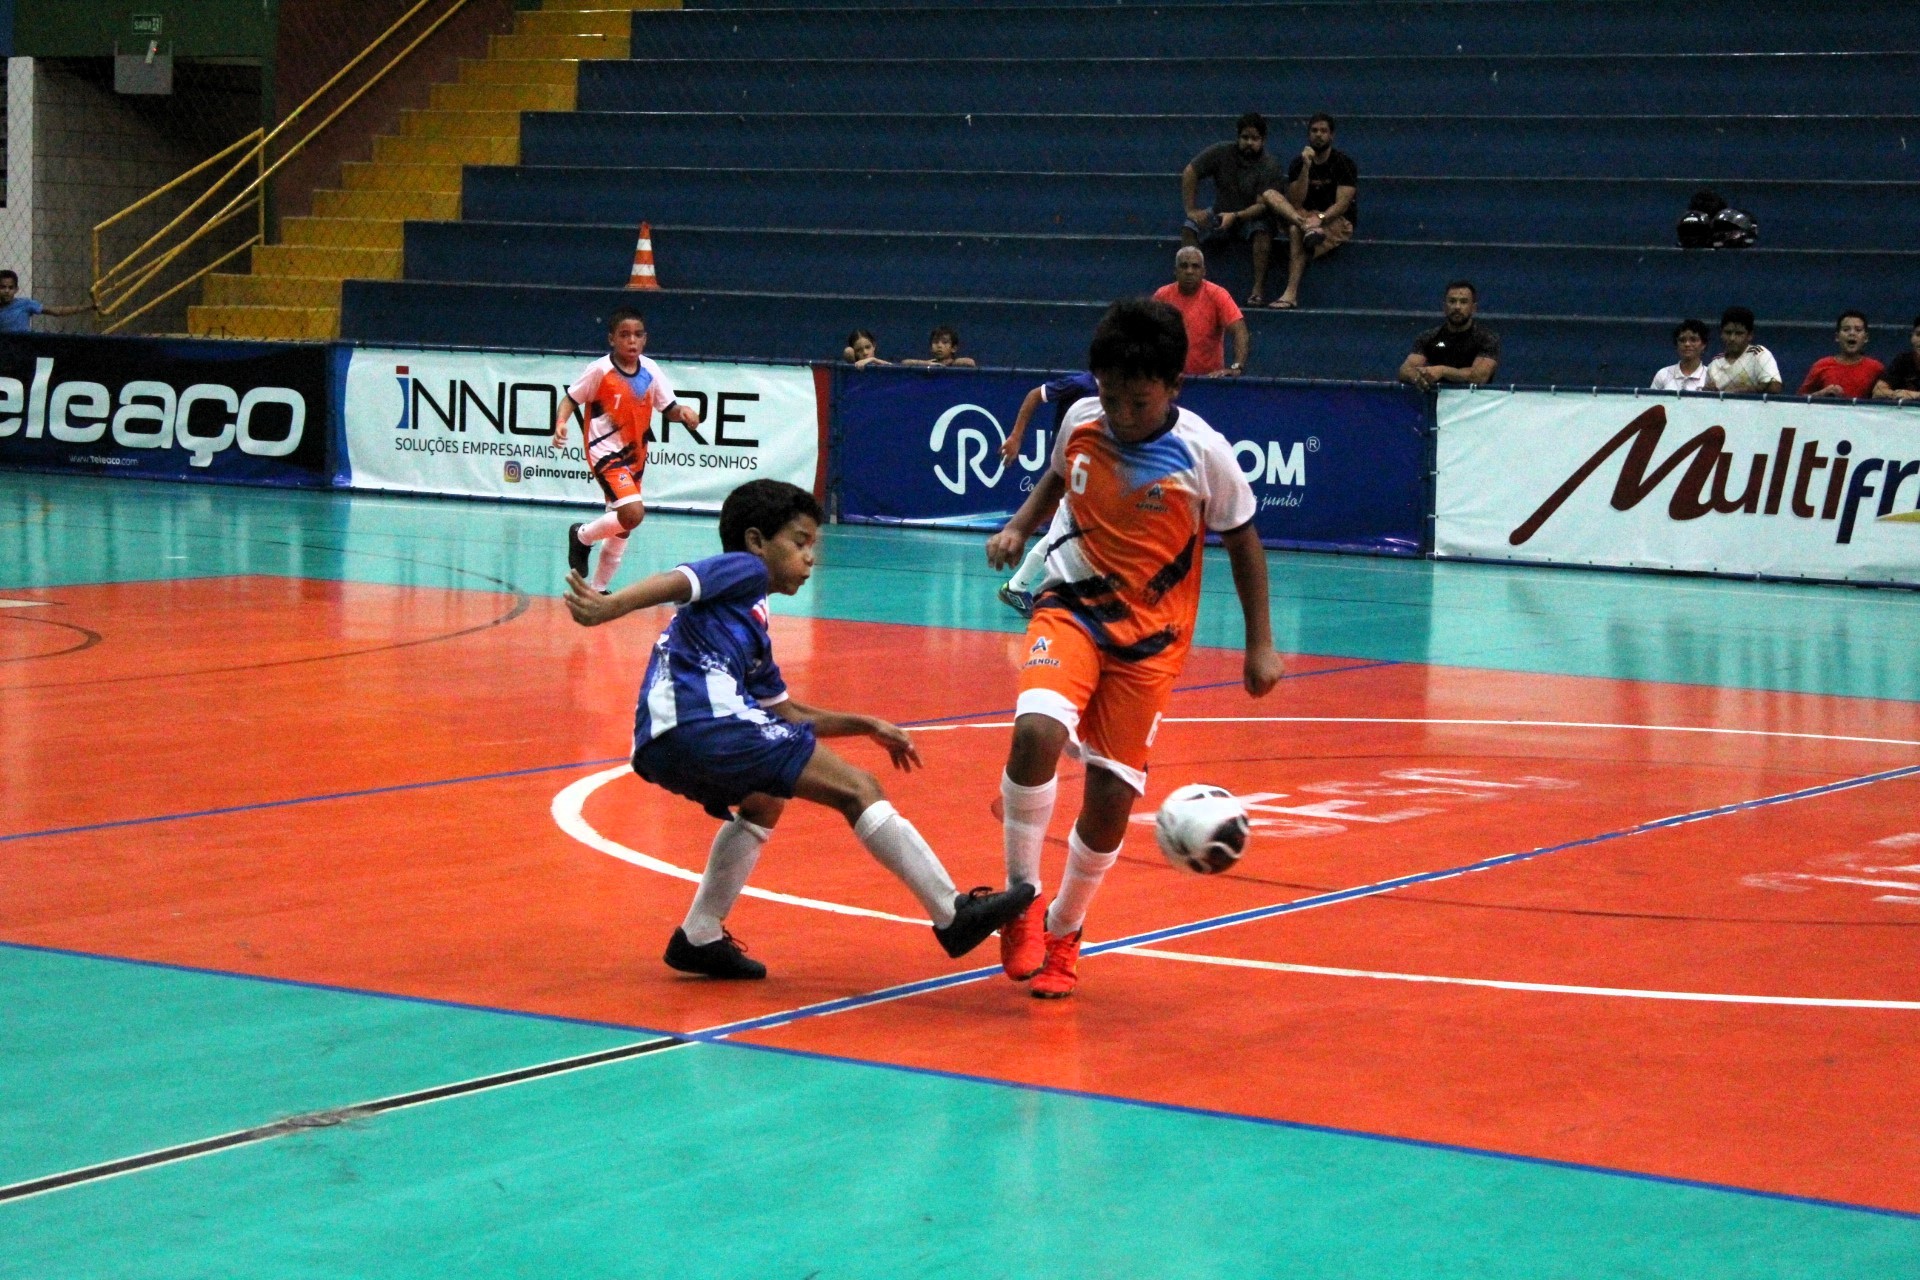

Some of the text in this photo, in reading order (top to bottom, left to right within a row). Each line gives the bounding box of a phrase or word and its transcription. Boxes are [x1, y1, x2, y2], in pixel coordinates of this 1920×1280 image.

[395, 436, 459, 455] SOLUÇÕES
[463, 441, 558, 461] EMPRESARIAIS,
[561, 446, 588, 462] AQU
[699, 454, 758, 470] SONHOS
[523, 465, 595, 483] @innovarep
[1070, 453, 1091, 495] 6
[1509, 404, 1920, 545] Multifr
[1260, 491, 1304, 512] junto!
